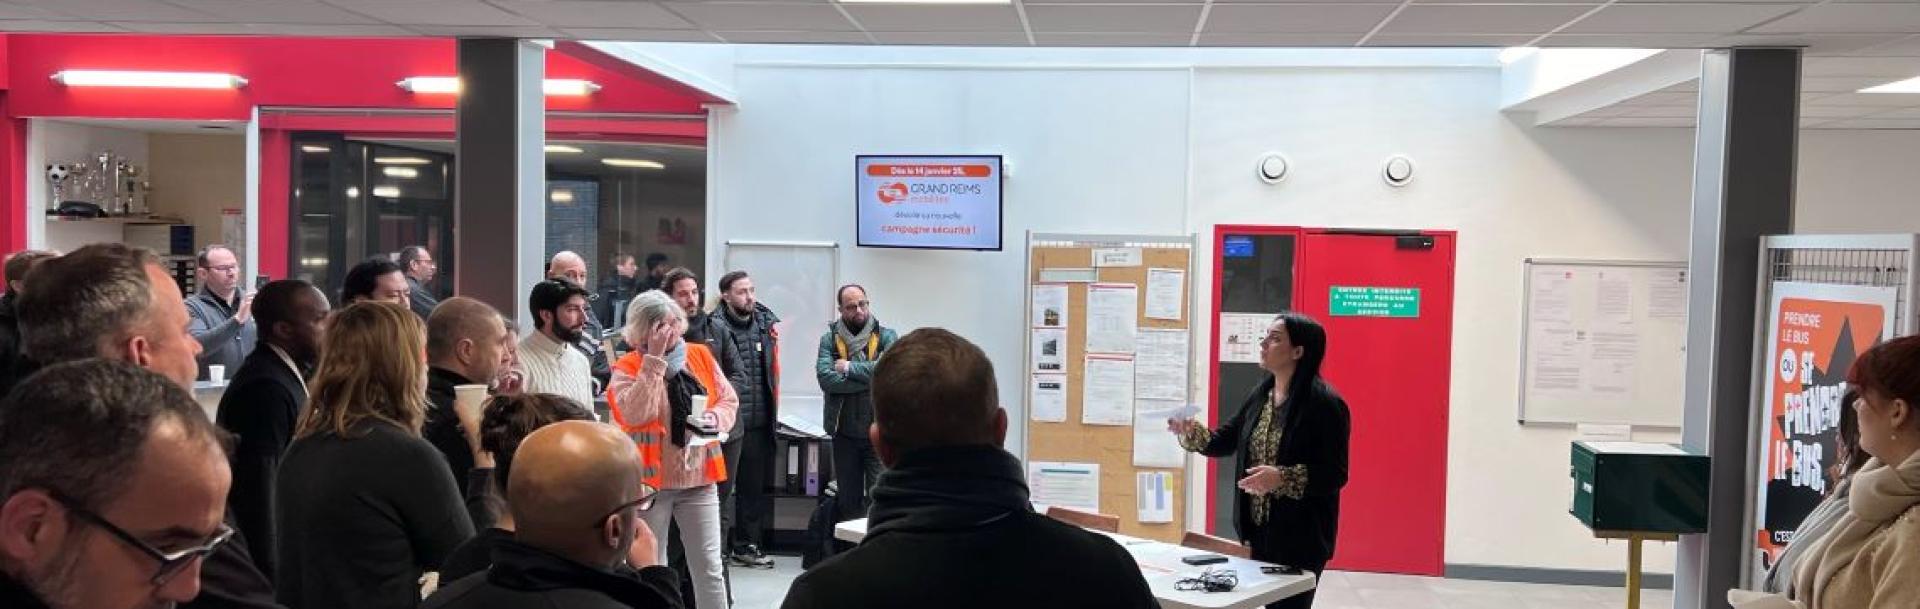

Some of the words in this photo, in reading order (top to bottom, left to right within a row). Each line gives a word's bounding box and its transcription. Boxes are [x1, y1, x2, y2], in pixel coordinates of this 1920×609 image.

[915, 166, 924, 175] 14
[924, 166, 952, 176] janvier
[911, 183, 948, 194] GRAND
[949, 183, 981, 195] REIMS
[881, 225, 930, 235] campagne
[932, 224, 971, 235] sécurité
[1783, 311, 1822, 328] PRENDRE
[1782, 328, 1793, 342] LE
[1793, 330, 1810, 345] BUS
[1782, 358, 1795, 374] OU
[1792, 440, 1825, 495] BUS,
